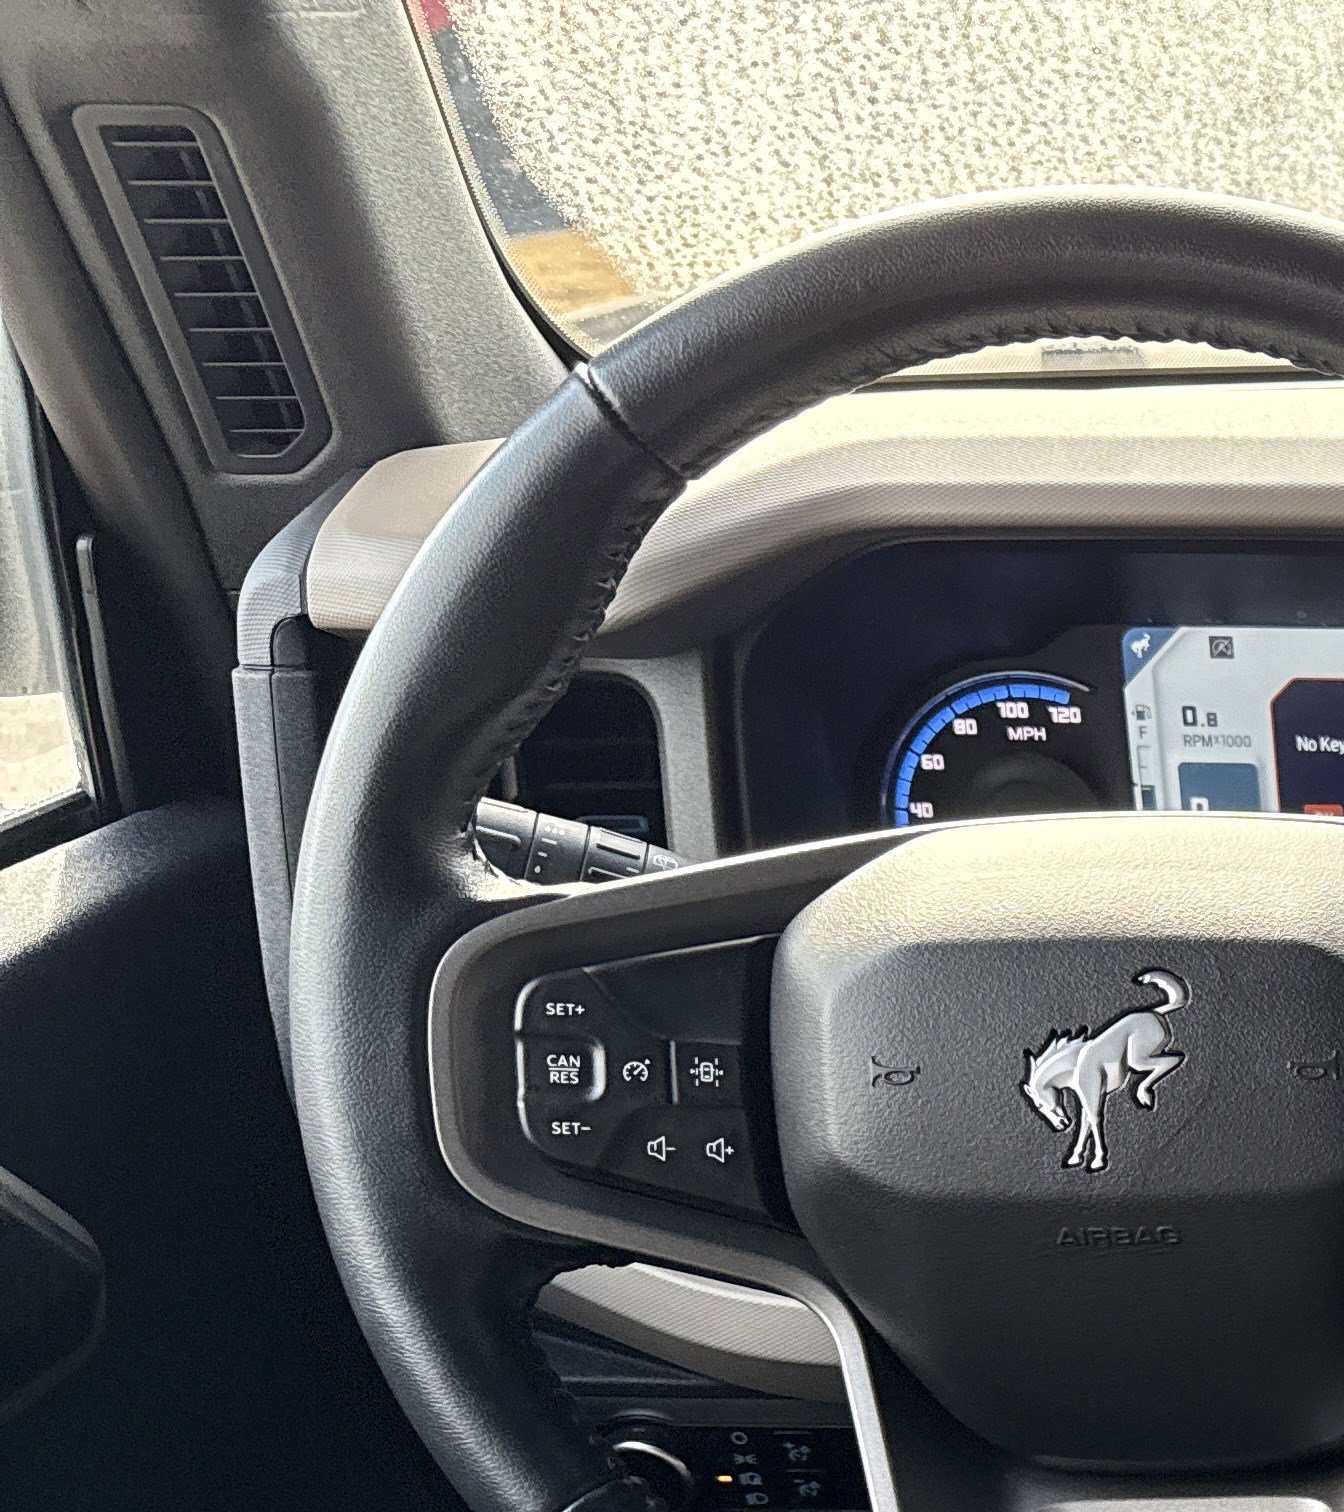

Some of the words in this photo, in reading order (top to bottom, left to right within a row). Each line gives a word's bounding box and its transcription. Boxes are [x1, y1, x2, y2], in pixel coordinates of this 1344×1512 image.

[997, 702, 1029, 718] 100
[1047, 706, 1081, 723] 120
[953, 718, 977, 735] 80
[1006, 726, 1046, 741] MPH
[1295, 736, 1318, 752] No
[921, 754, 944, 770] 60
[909, 802, 933, 818] 40
[546, 1054, 581, 1068] CAN
[549, 1071, 579, 1084] RES
[1054, 1223, 1180, 1246] AIRBAG
